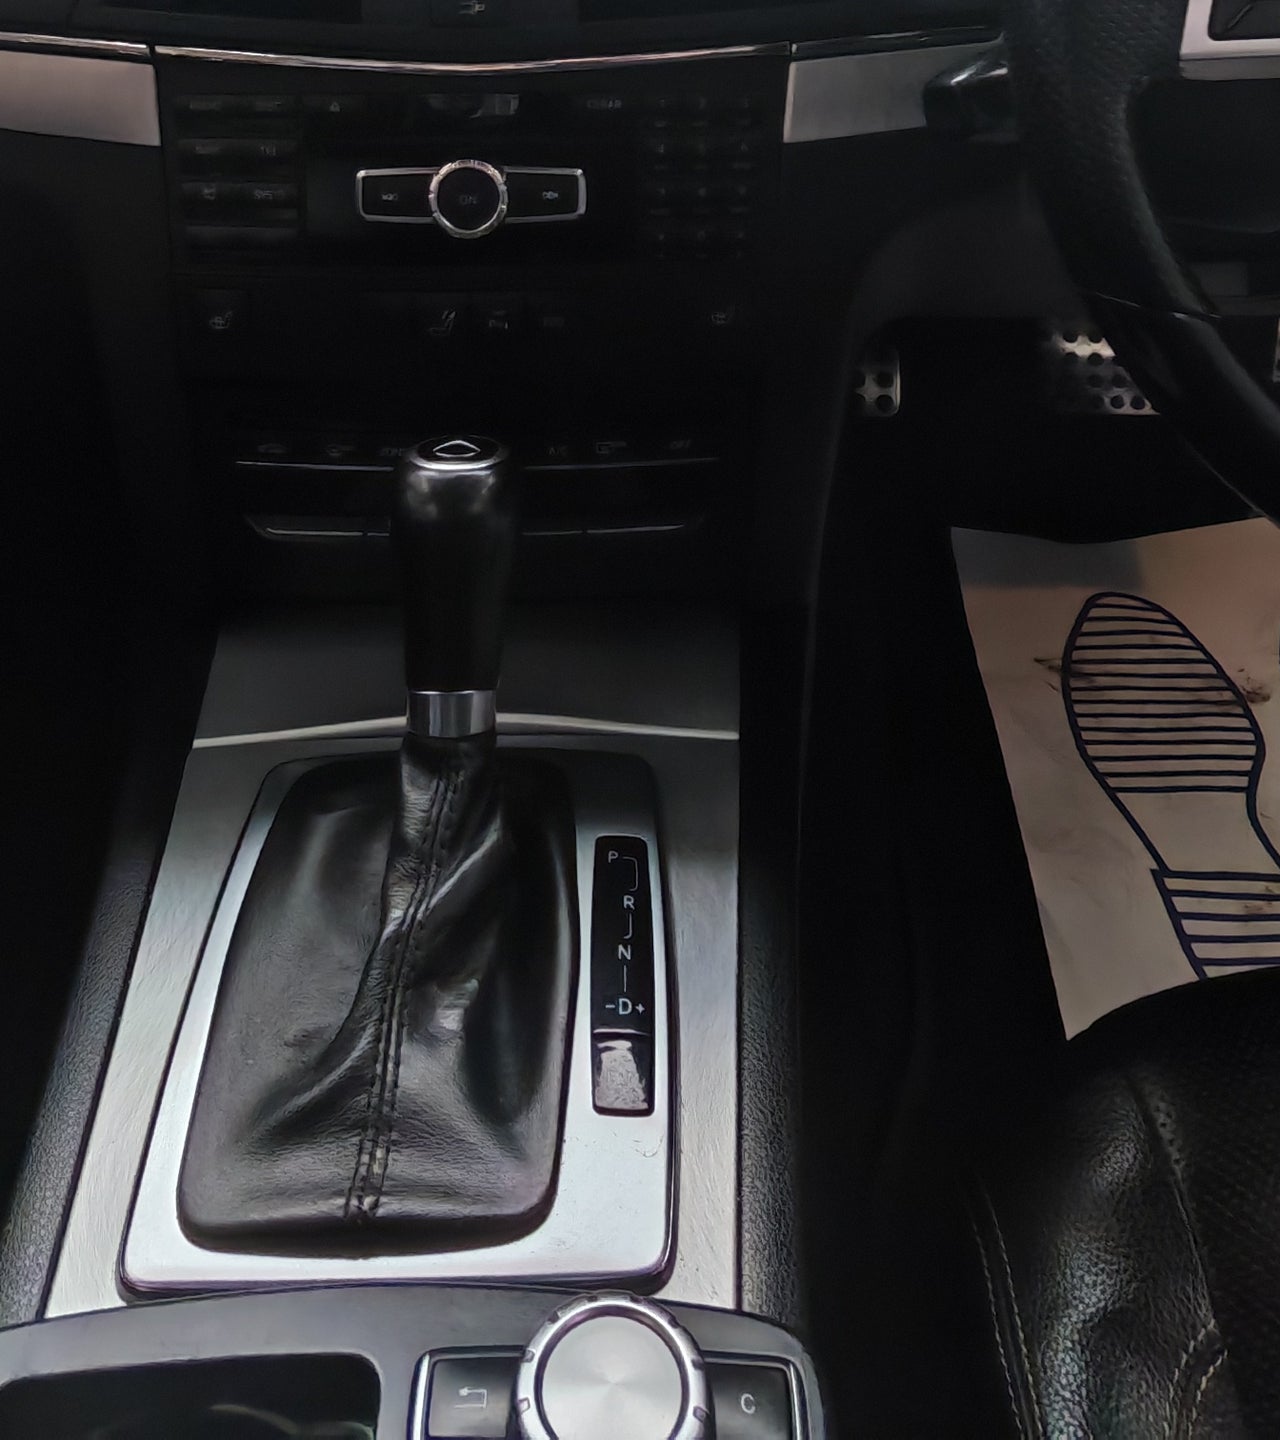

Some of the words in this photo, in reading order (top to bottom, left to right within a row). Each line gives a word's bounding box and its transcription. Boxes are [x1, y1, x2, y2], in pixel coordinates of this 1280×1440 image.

[607, 850, 619, 863] P
[623, 895, 635, 910] R
[617, 944, 632, 961] N
[740, 1392, 757, 1415] C
